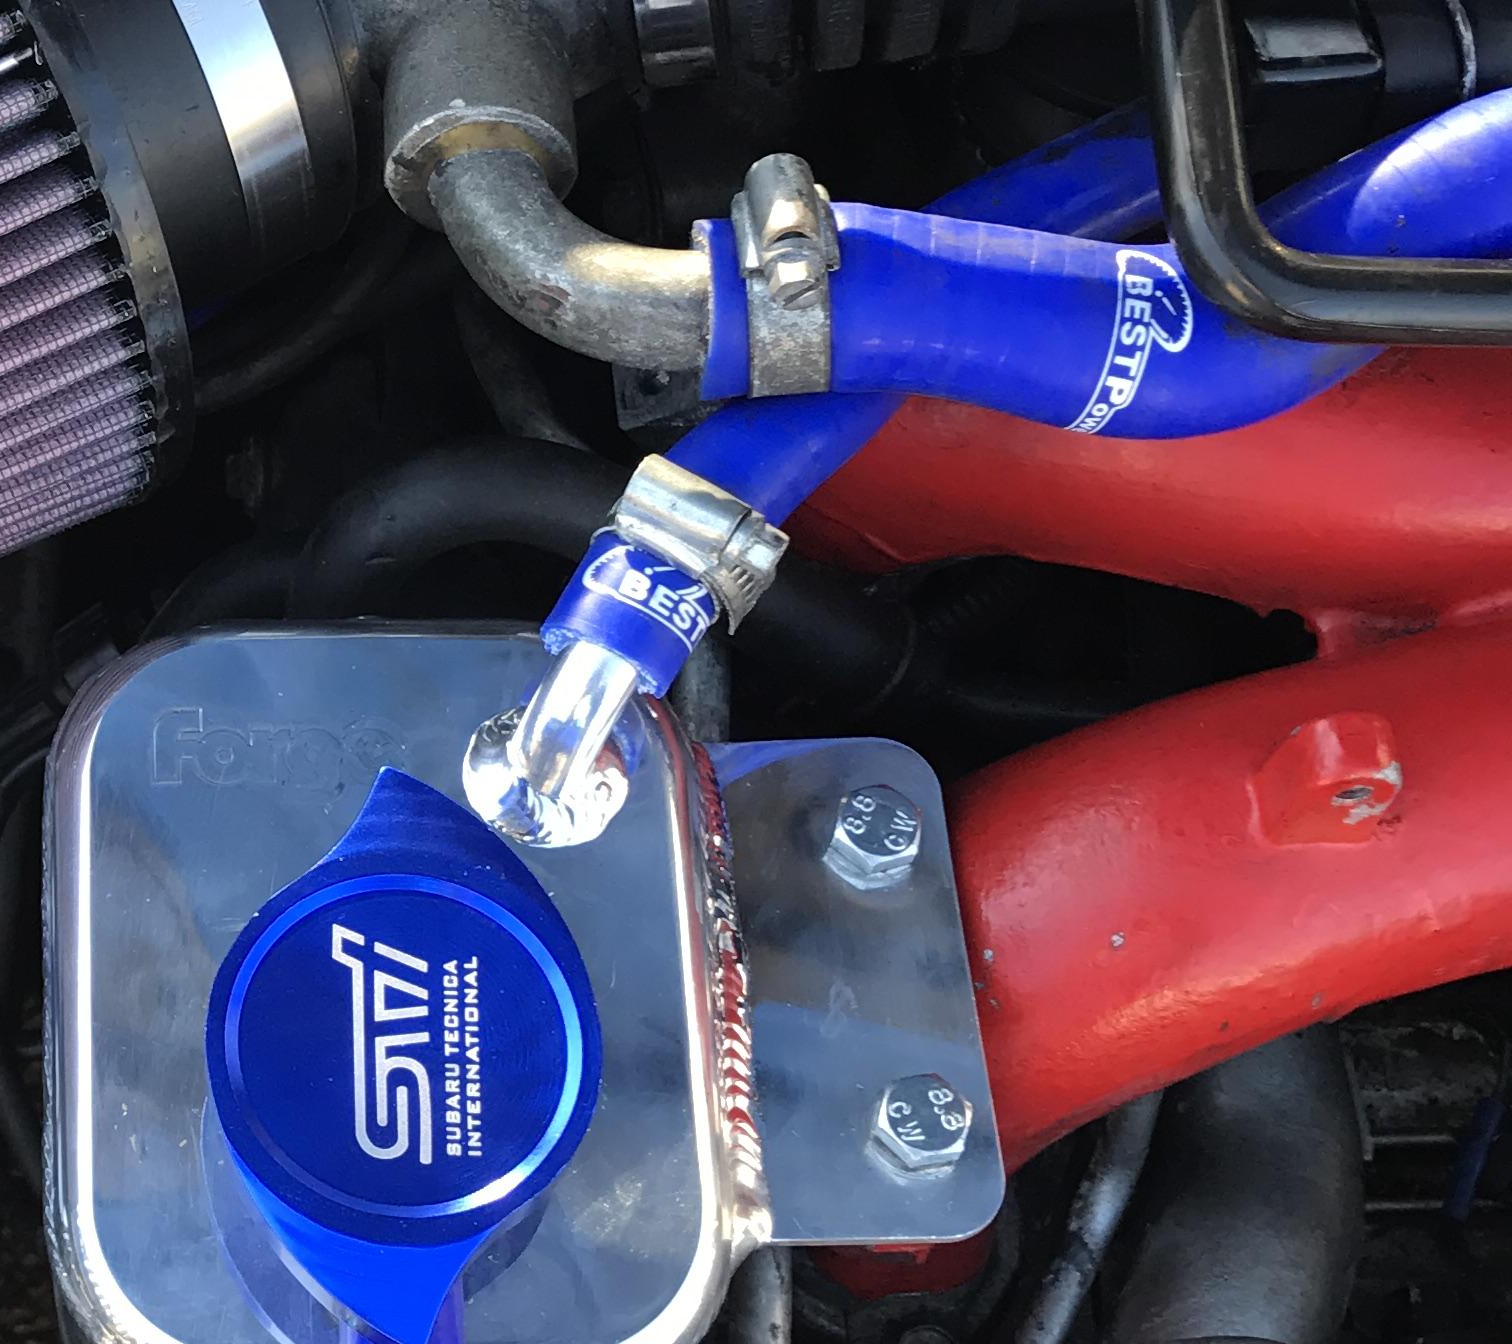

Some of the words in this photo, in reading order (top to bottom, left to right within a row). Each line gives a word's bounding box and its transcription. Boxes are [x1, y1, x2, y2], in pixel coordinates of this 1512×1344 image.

[443, 959, 459, 1060] TECNICA
[461, 955, 484, 1158] INTERNATIONAL
[444, 1063, 462, 1157] SUBARU
